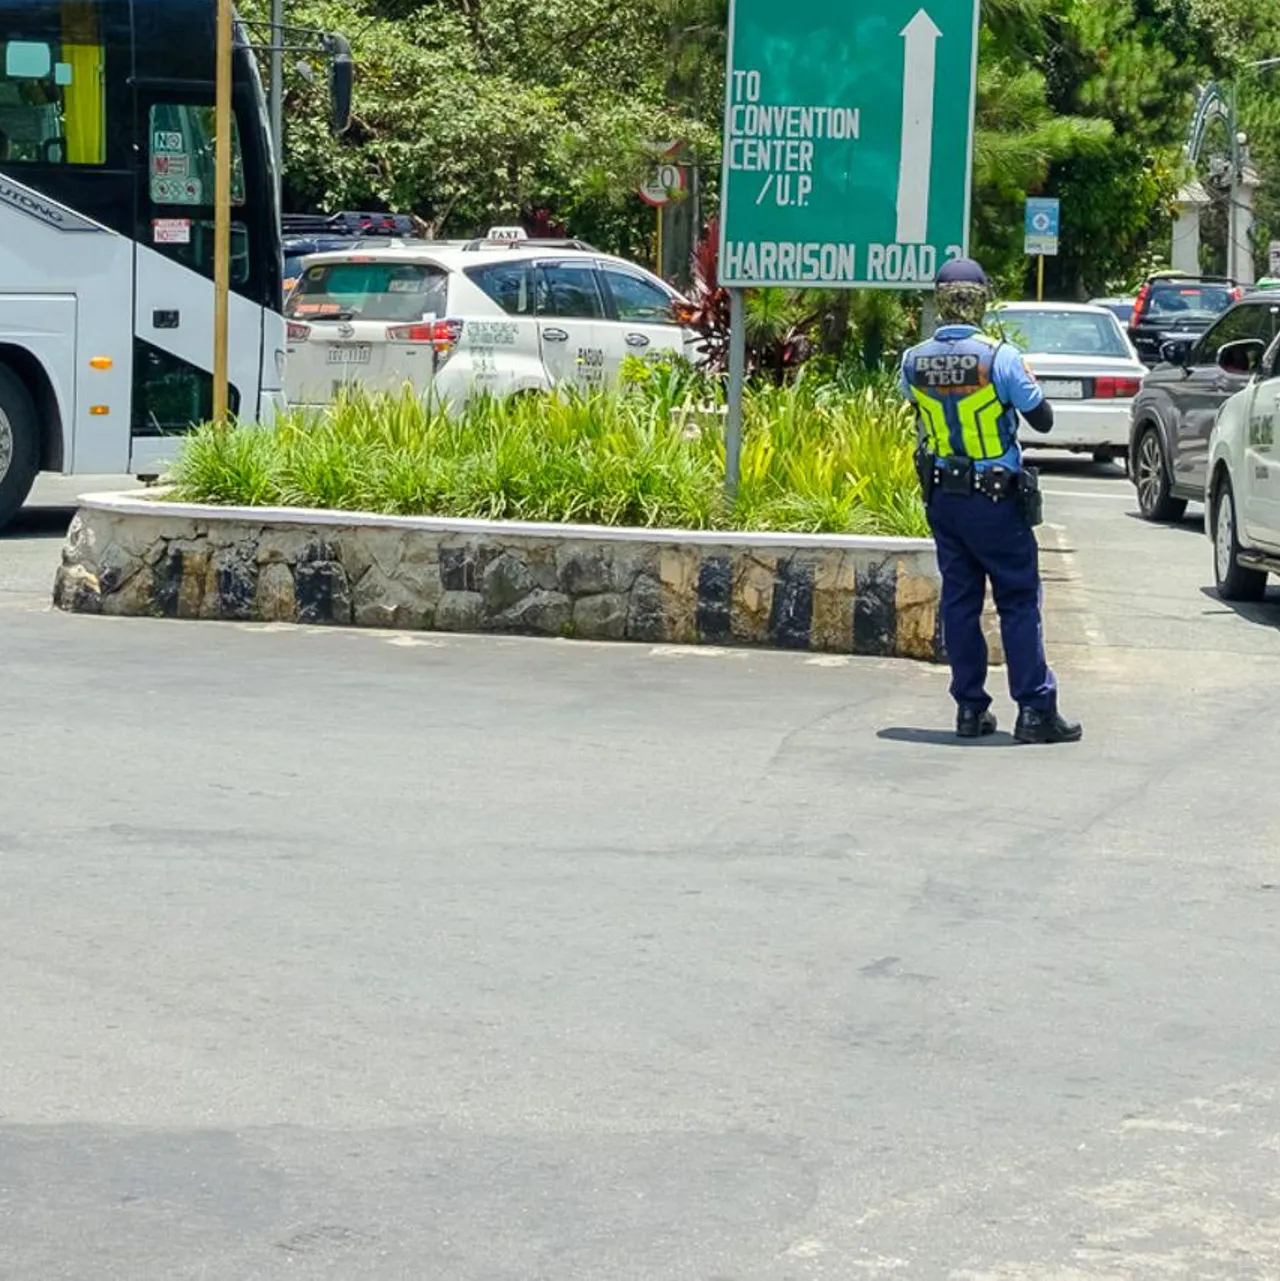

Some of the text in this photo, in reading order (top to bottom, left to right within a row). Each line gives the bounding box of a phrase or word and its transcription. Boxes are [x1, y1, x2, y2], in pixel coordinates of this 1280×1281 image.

[733, 70, 761, 102] TO
[730, 105, 860, 139] CONVENTION
[729, 138, 814, 171] CENTER
[491, 230, 520, 240] TAXI
[726, 241, 856, 281] HARRISON
[867, 243, 936, 281] ROAD
[916, 355, 977, 372] BCPO
[925, 369, 965, 385] TEU
